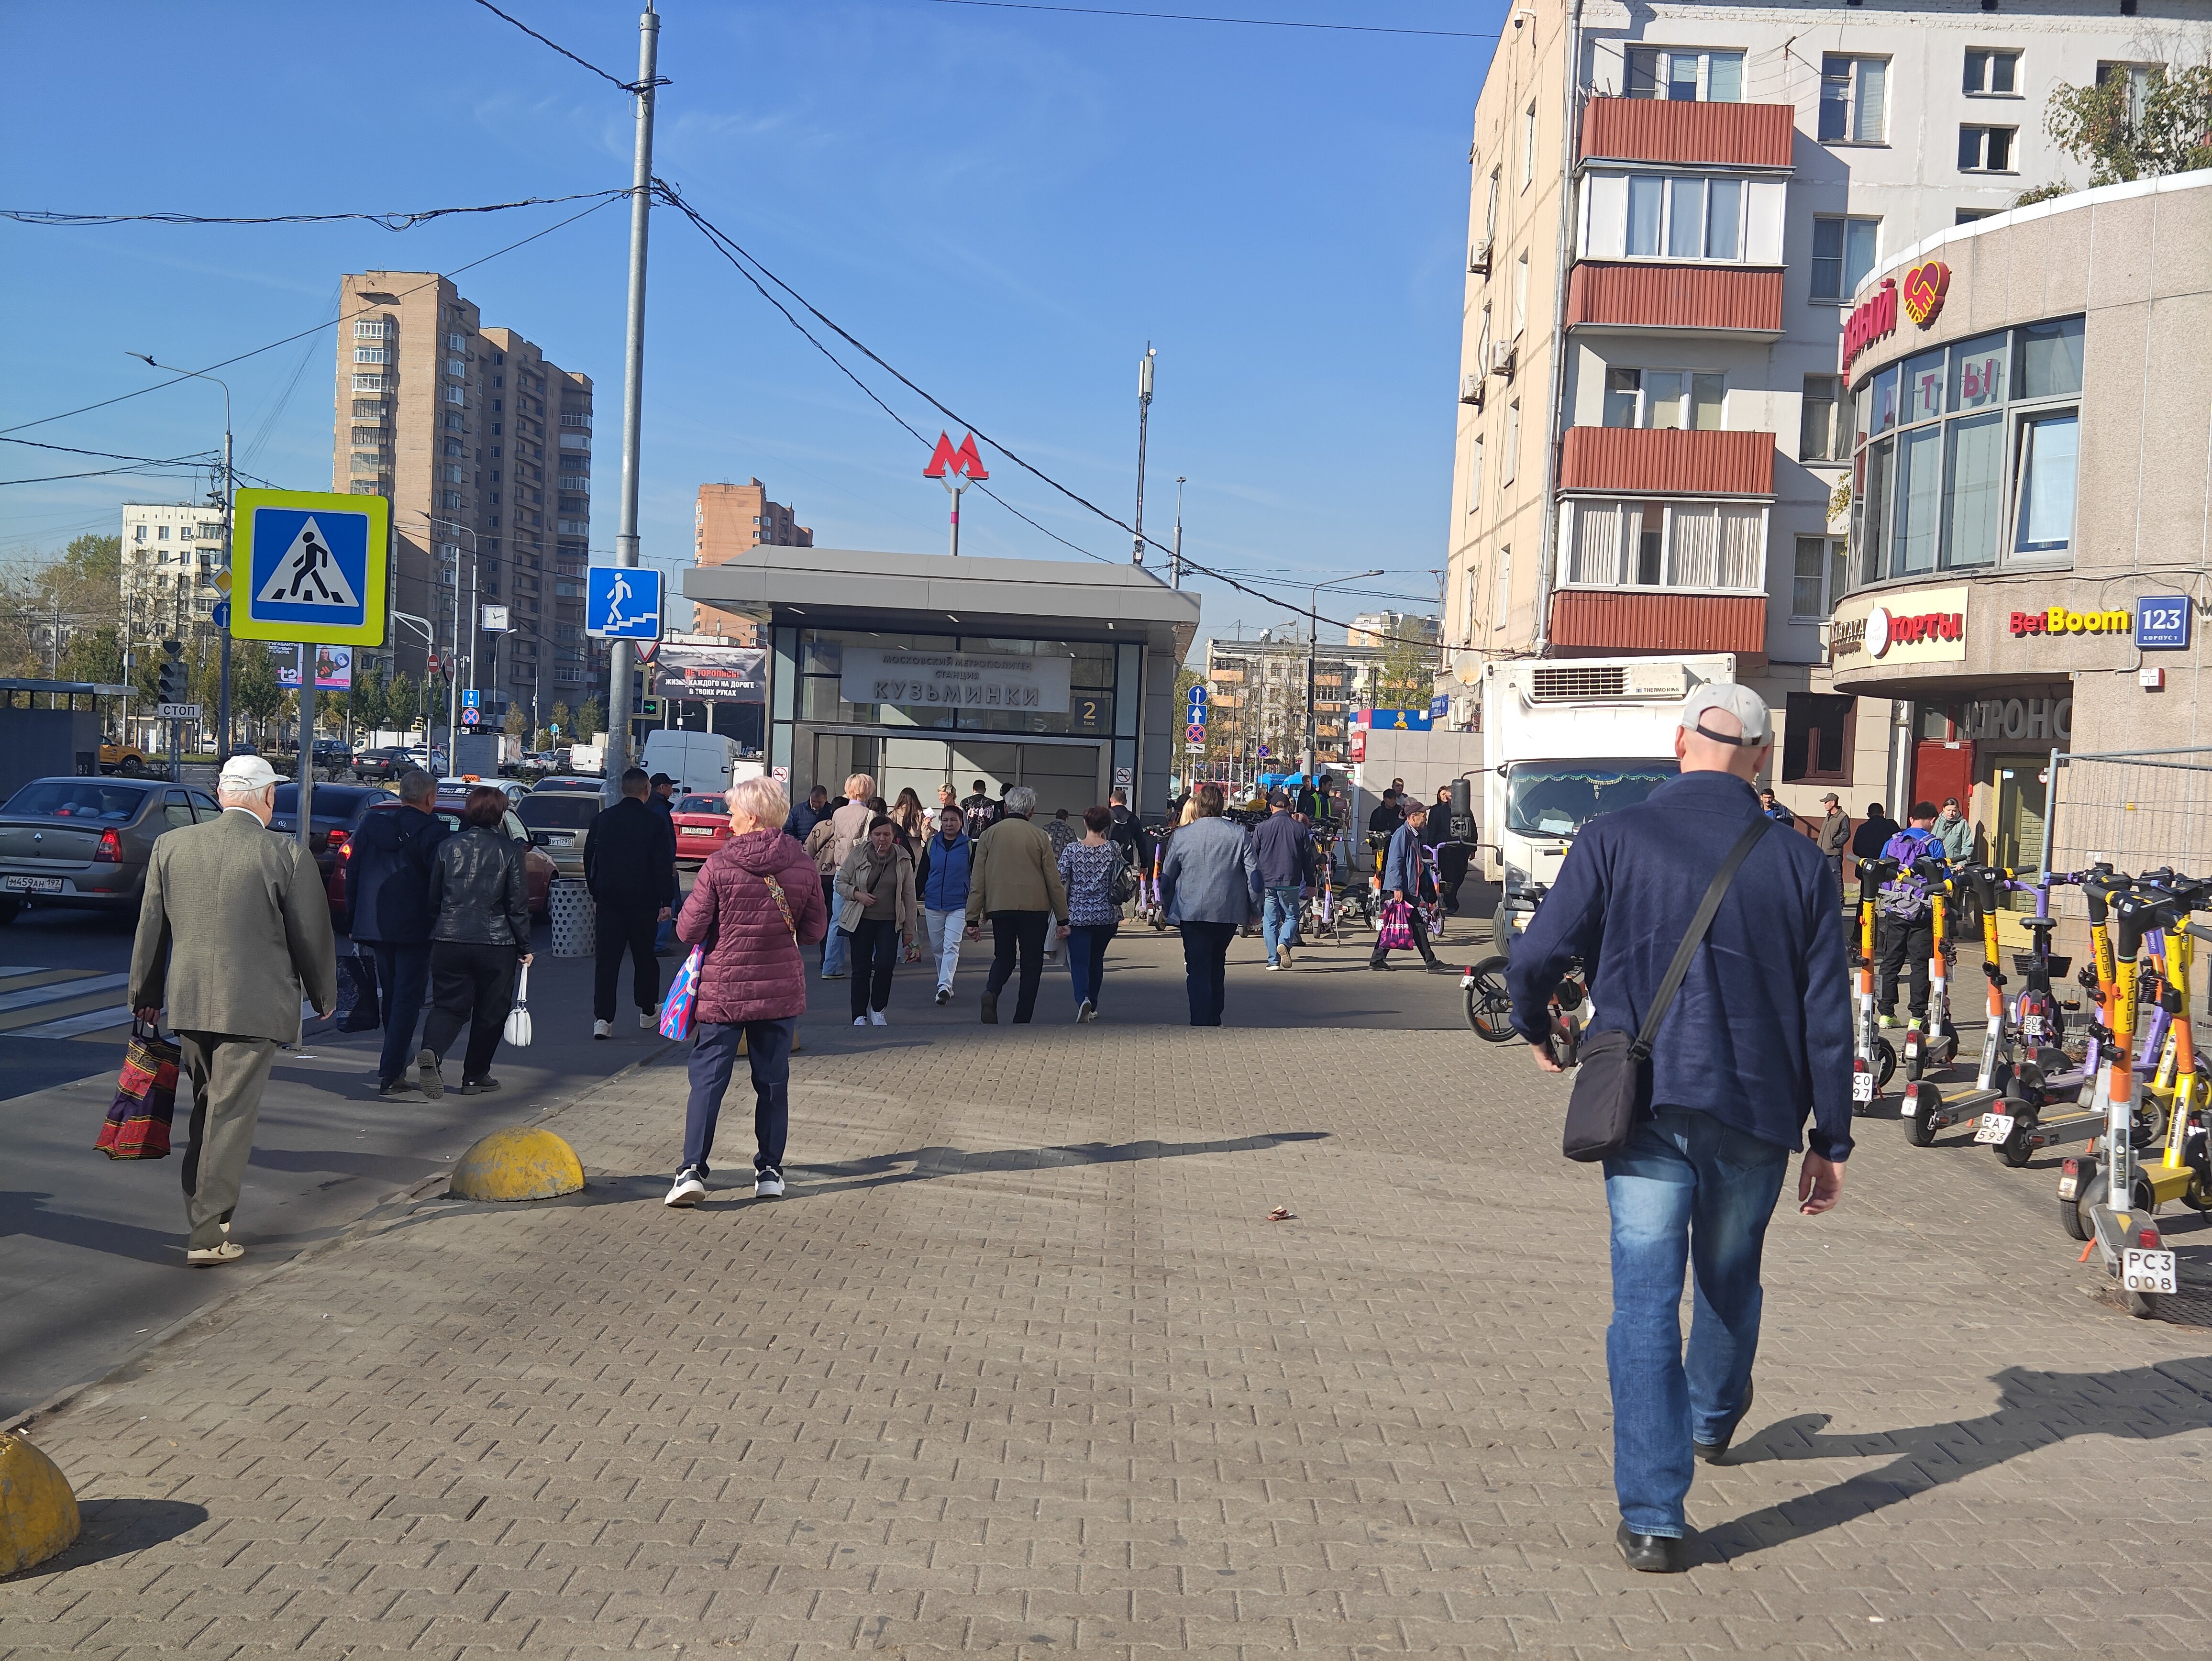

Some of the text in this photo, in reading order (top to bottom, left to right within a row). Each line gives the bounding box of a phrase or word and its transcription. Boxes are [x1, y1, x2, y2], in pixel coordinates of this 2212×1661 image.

[1890, 613, 1961, 642] ТОРТЫ
[2009, 607, 2130, 633] BetBoom
[2142, 609, 2181, 630] 123
[883, 655, 1032, 670] МОСКОВСКИЙ МЕТРОПОЛИТЕН
[697, 669, 740, 678] ТОРОПИСЬ!
[935, 671, 979, 680] СТАНЦИЯ
[875, 681, 1040, 706] КУЗЬМИНКИ
[164, 706, 195, 716] СТОП
[1084, 702, 1096, 719] 2
[10, 878, 44, 887] М459АН
[2098, 930, 2111, 979] WHOOSH
[2126, 967, 2135, 1032] WHOOSH
[1984, 1116, 2012, 1130] РА7
[1978, 1131, 2006, 1141] 593
[2129, 1252, 2171, 1271] РС3
[2129, 1275, 2172, 1290] 008
